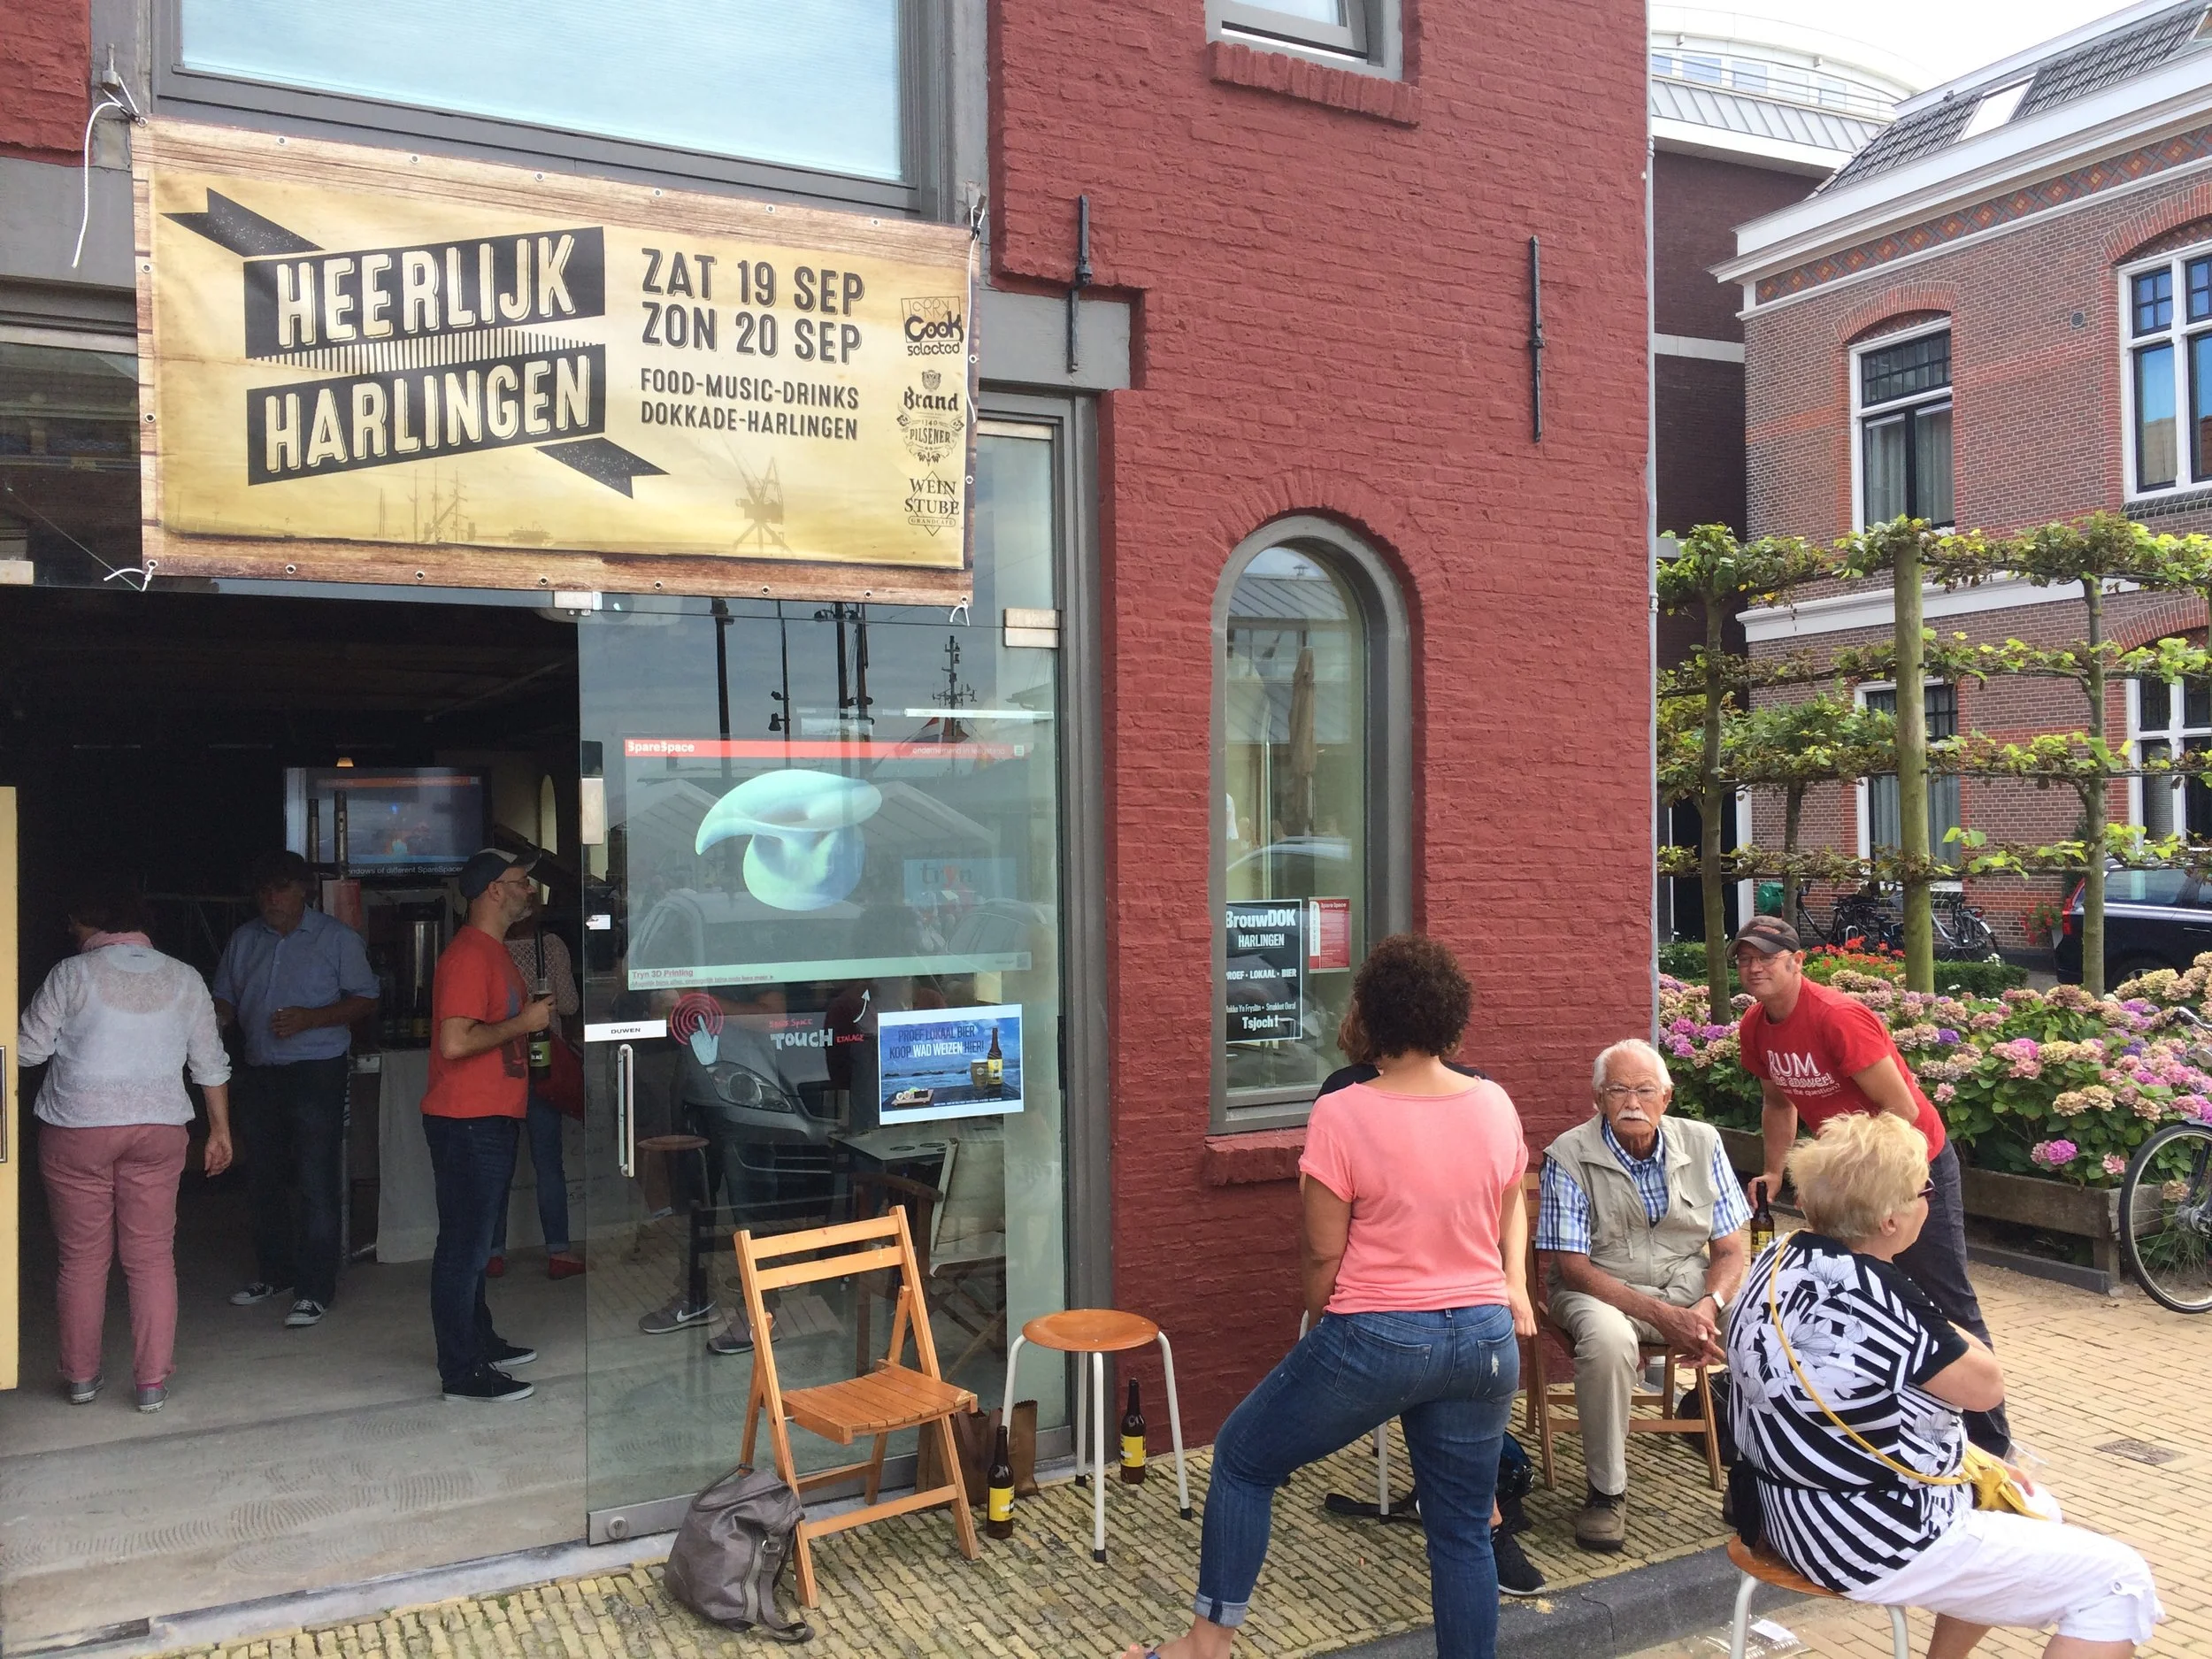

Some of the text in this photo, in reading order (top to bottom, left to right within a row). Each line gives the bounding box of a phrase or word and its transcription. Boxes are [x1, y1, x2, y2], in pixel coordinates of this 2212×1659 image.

[276, 234, 576, 349] HEERLIJK
[641, 248, 865, 317] ZAT 19 SEP
[641, 301, 863, 365] ZON 20 SEP
[904, 311, 964, 343] Cook
[641, 367, 859, 411] FOOD-MUSIC-DRINKS
[903, 386, 959, 411] Brand
[265, 354, 591, 474] HARLINGEN
[641, 402, 858, 441] DOKKADE-HARLINGEN
[910, 427, 951, 445] PILSENER
[910, 478, 956, 495] WEIN
[904, 498, 960, 515] STUBE
[1226, 909, 1296, 928] BrouwDOK
[1238, 933, 1285, 948] HARLINGEN
[664, 969, 694, 978] Printing
[1249, 970, 1276, 979] LOKAAL
[1281, 968, 1297, 978] BIER
[898, 1025, 975, 1042] PROEF LOKAAL BIER
[889, 1040, 984, 1059] KOOP WAD WEIZEN HIER!
[1767, 1049, 1821, 1078] RUM
[1787, 1072, 1835, 1088] answer!
[1804, 1083, 1841, 1097] question?
